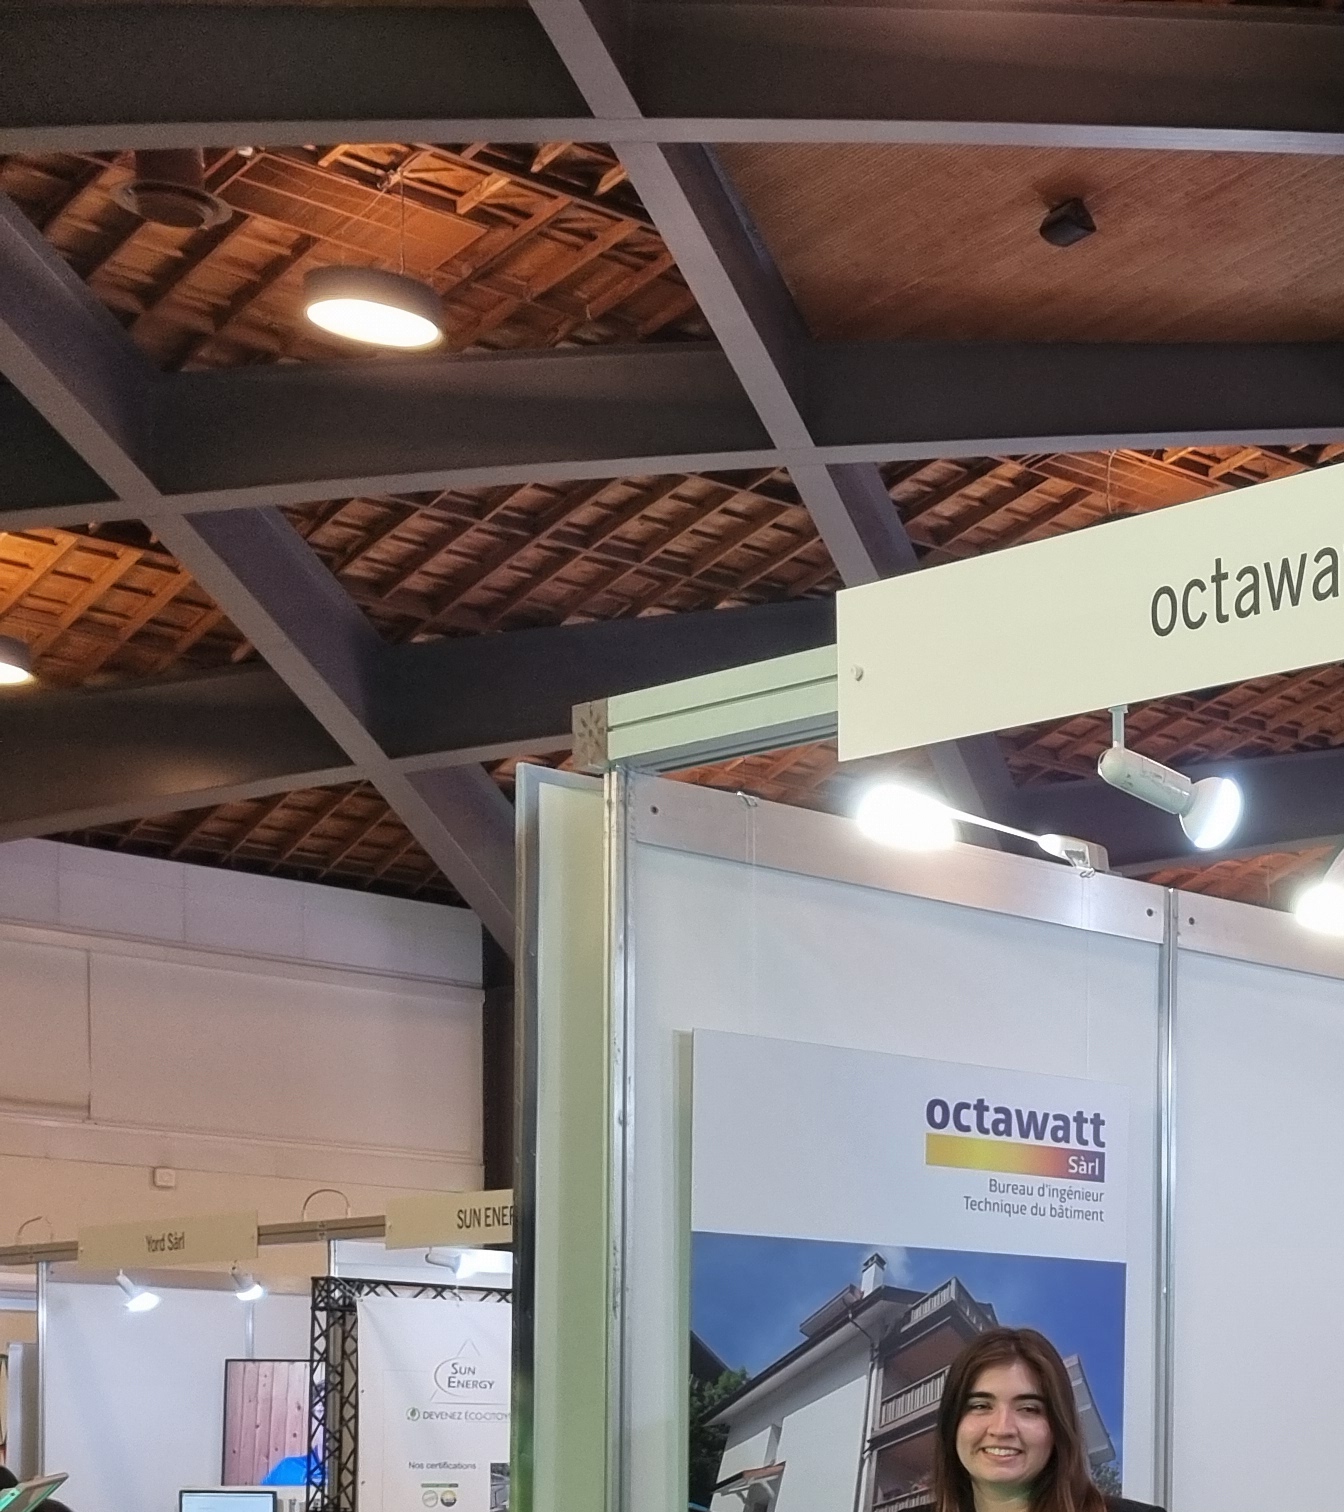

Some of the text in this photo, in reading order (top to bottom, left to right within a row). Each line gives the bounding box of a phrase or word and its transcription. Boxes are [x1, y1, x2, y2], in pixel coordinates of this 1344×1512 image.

[926, 1097, 1105, 1148] octawatt
[1067, 1154, 1099, 1176] Sàrl
[989, 1178, 1105, 1203] Bureau d'ingénieur
[456, 1208, 481, 1229] SUN
[963, 1195, 1105, 1222] Technique du bâtiment
[451, 1362, 476, 1377] SUN
[447, 1376, 495, 1390] ENERGY
[422, 1410, 462, 1421] DEVENEZ
[408, 1461, 477, 1470] Nos certifications
